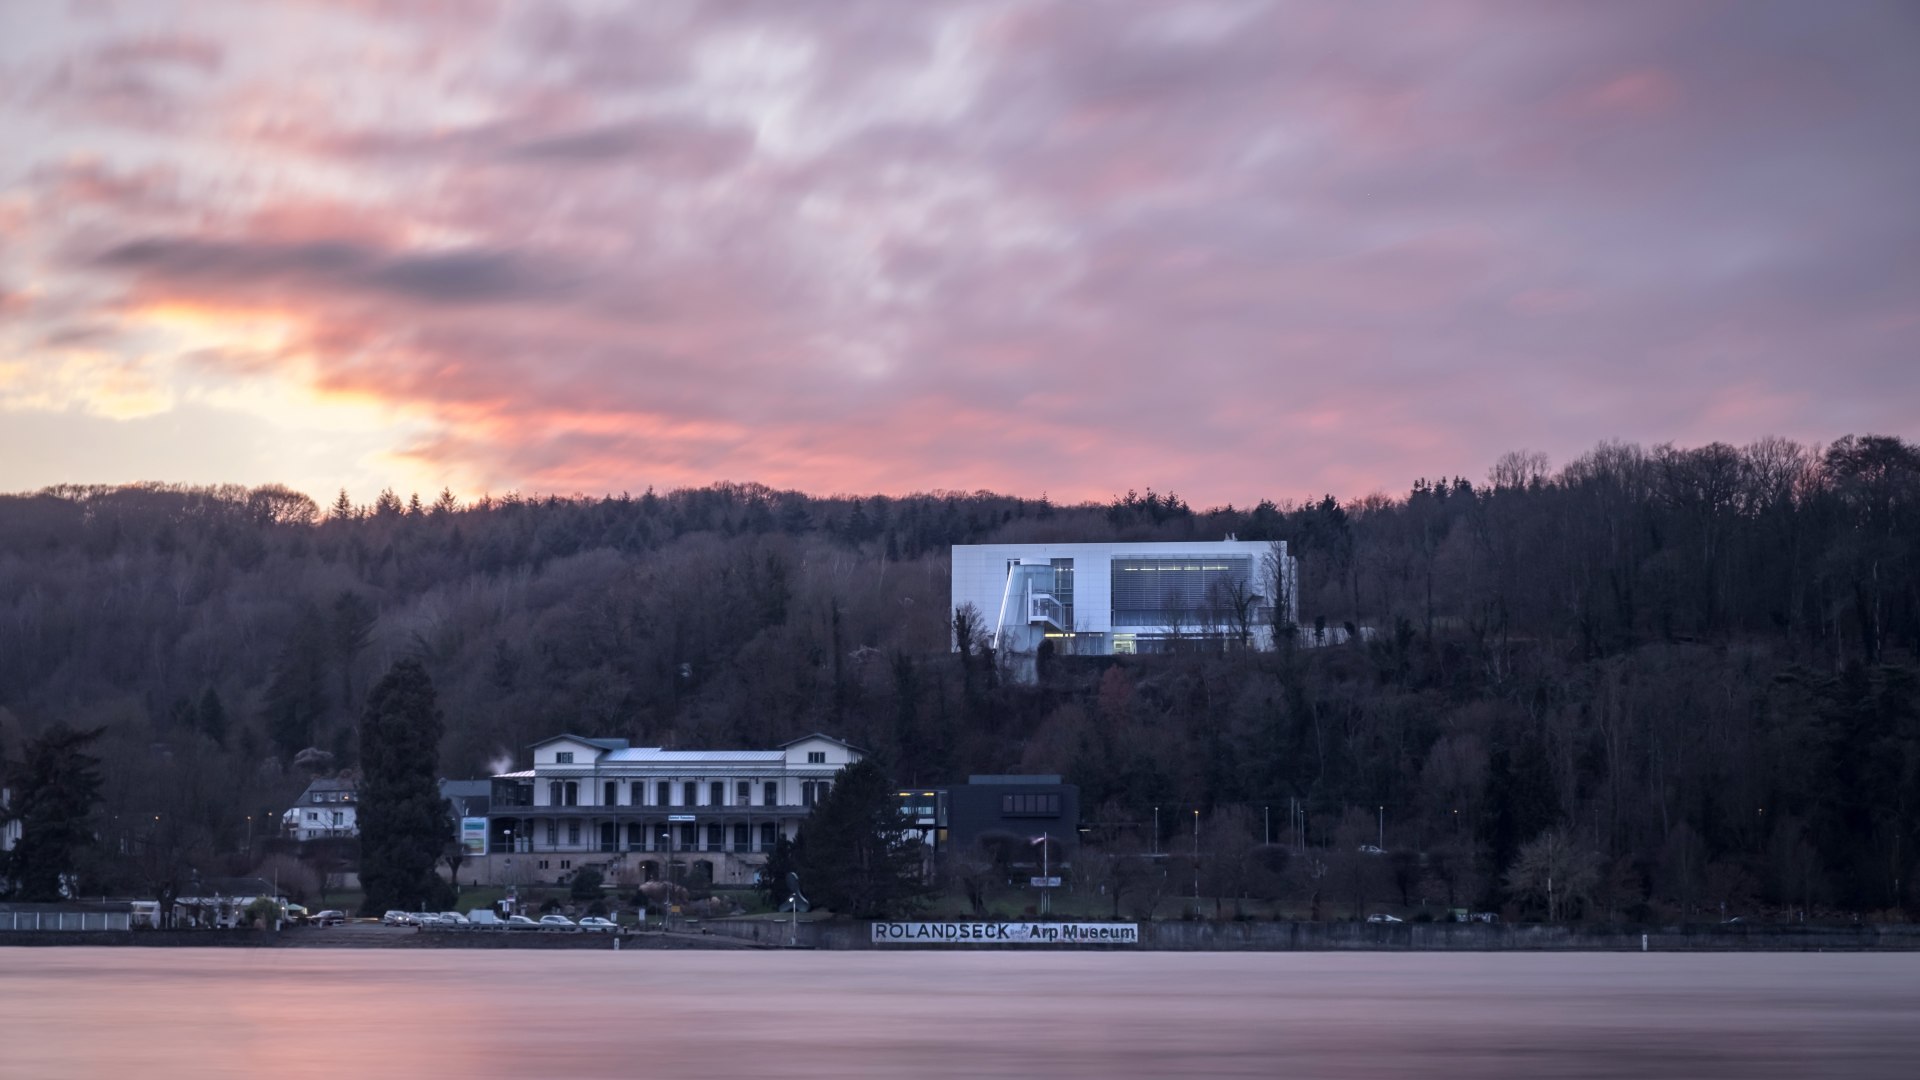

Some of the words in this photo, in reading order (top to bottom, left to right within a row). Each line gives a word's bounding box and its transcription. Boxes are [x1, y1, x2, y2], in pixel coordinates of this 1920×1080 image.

[876, 924, 1010, 939] ROLANDSECK
[1030, 925, 1058, 941] Arp
[1063, 925, 1136, 939] Museum
